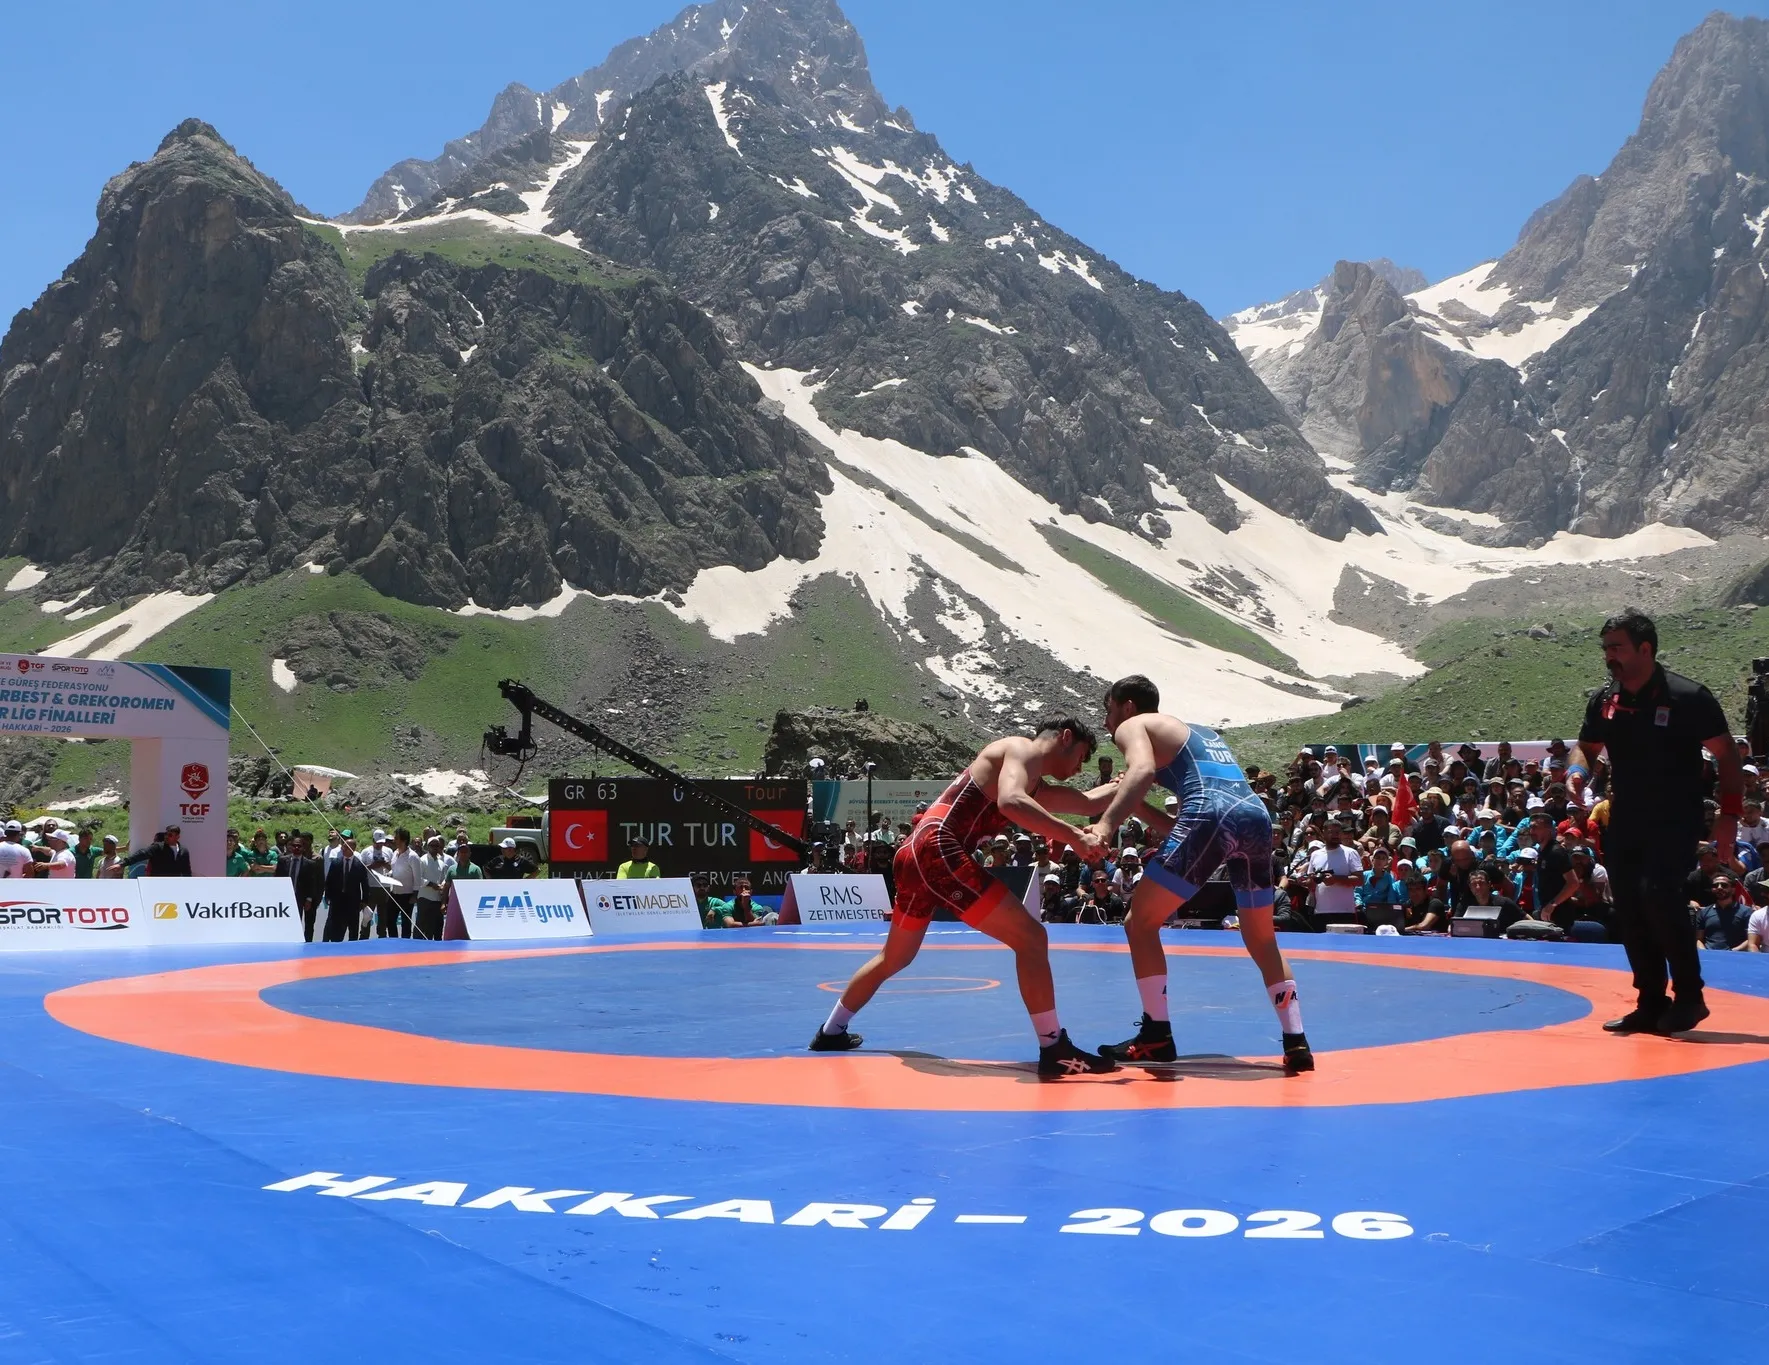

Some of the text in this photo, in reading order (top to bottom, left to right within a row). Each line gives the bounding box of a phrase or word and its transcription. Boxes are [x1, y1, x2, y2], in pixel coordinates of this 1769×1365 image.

[8, 677, 39, 690] GÜREŞ
[41, 680, 109, 692] FEDERASYONU
[52, 693, 63, 705] &
[68, 693, 175, 711] GREKOROMEN
[39, 706, 116, 725] FİNALLERİ
[51, 725, 72, 733] 2026
[1205, 748, 1235, 764] TUR
[564, 783, 617, 800] GR 63
[744, 785, 787, 800] Tour
[179, 803, 210, 816] TGF
[620, 822, 737, 847] TUR TUR
[819, 885, 863, 906] RMS
[185, 901, 290, 919] VakıfBank
[808, 909, 884, 921] ZEITMEISTER
[1059, 1207, 1415, 1240] 2026
